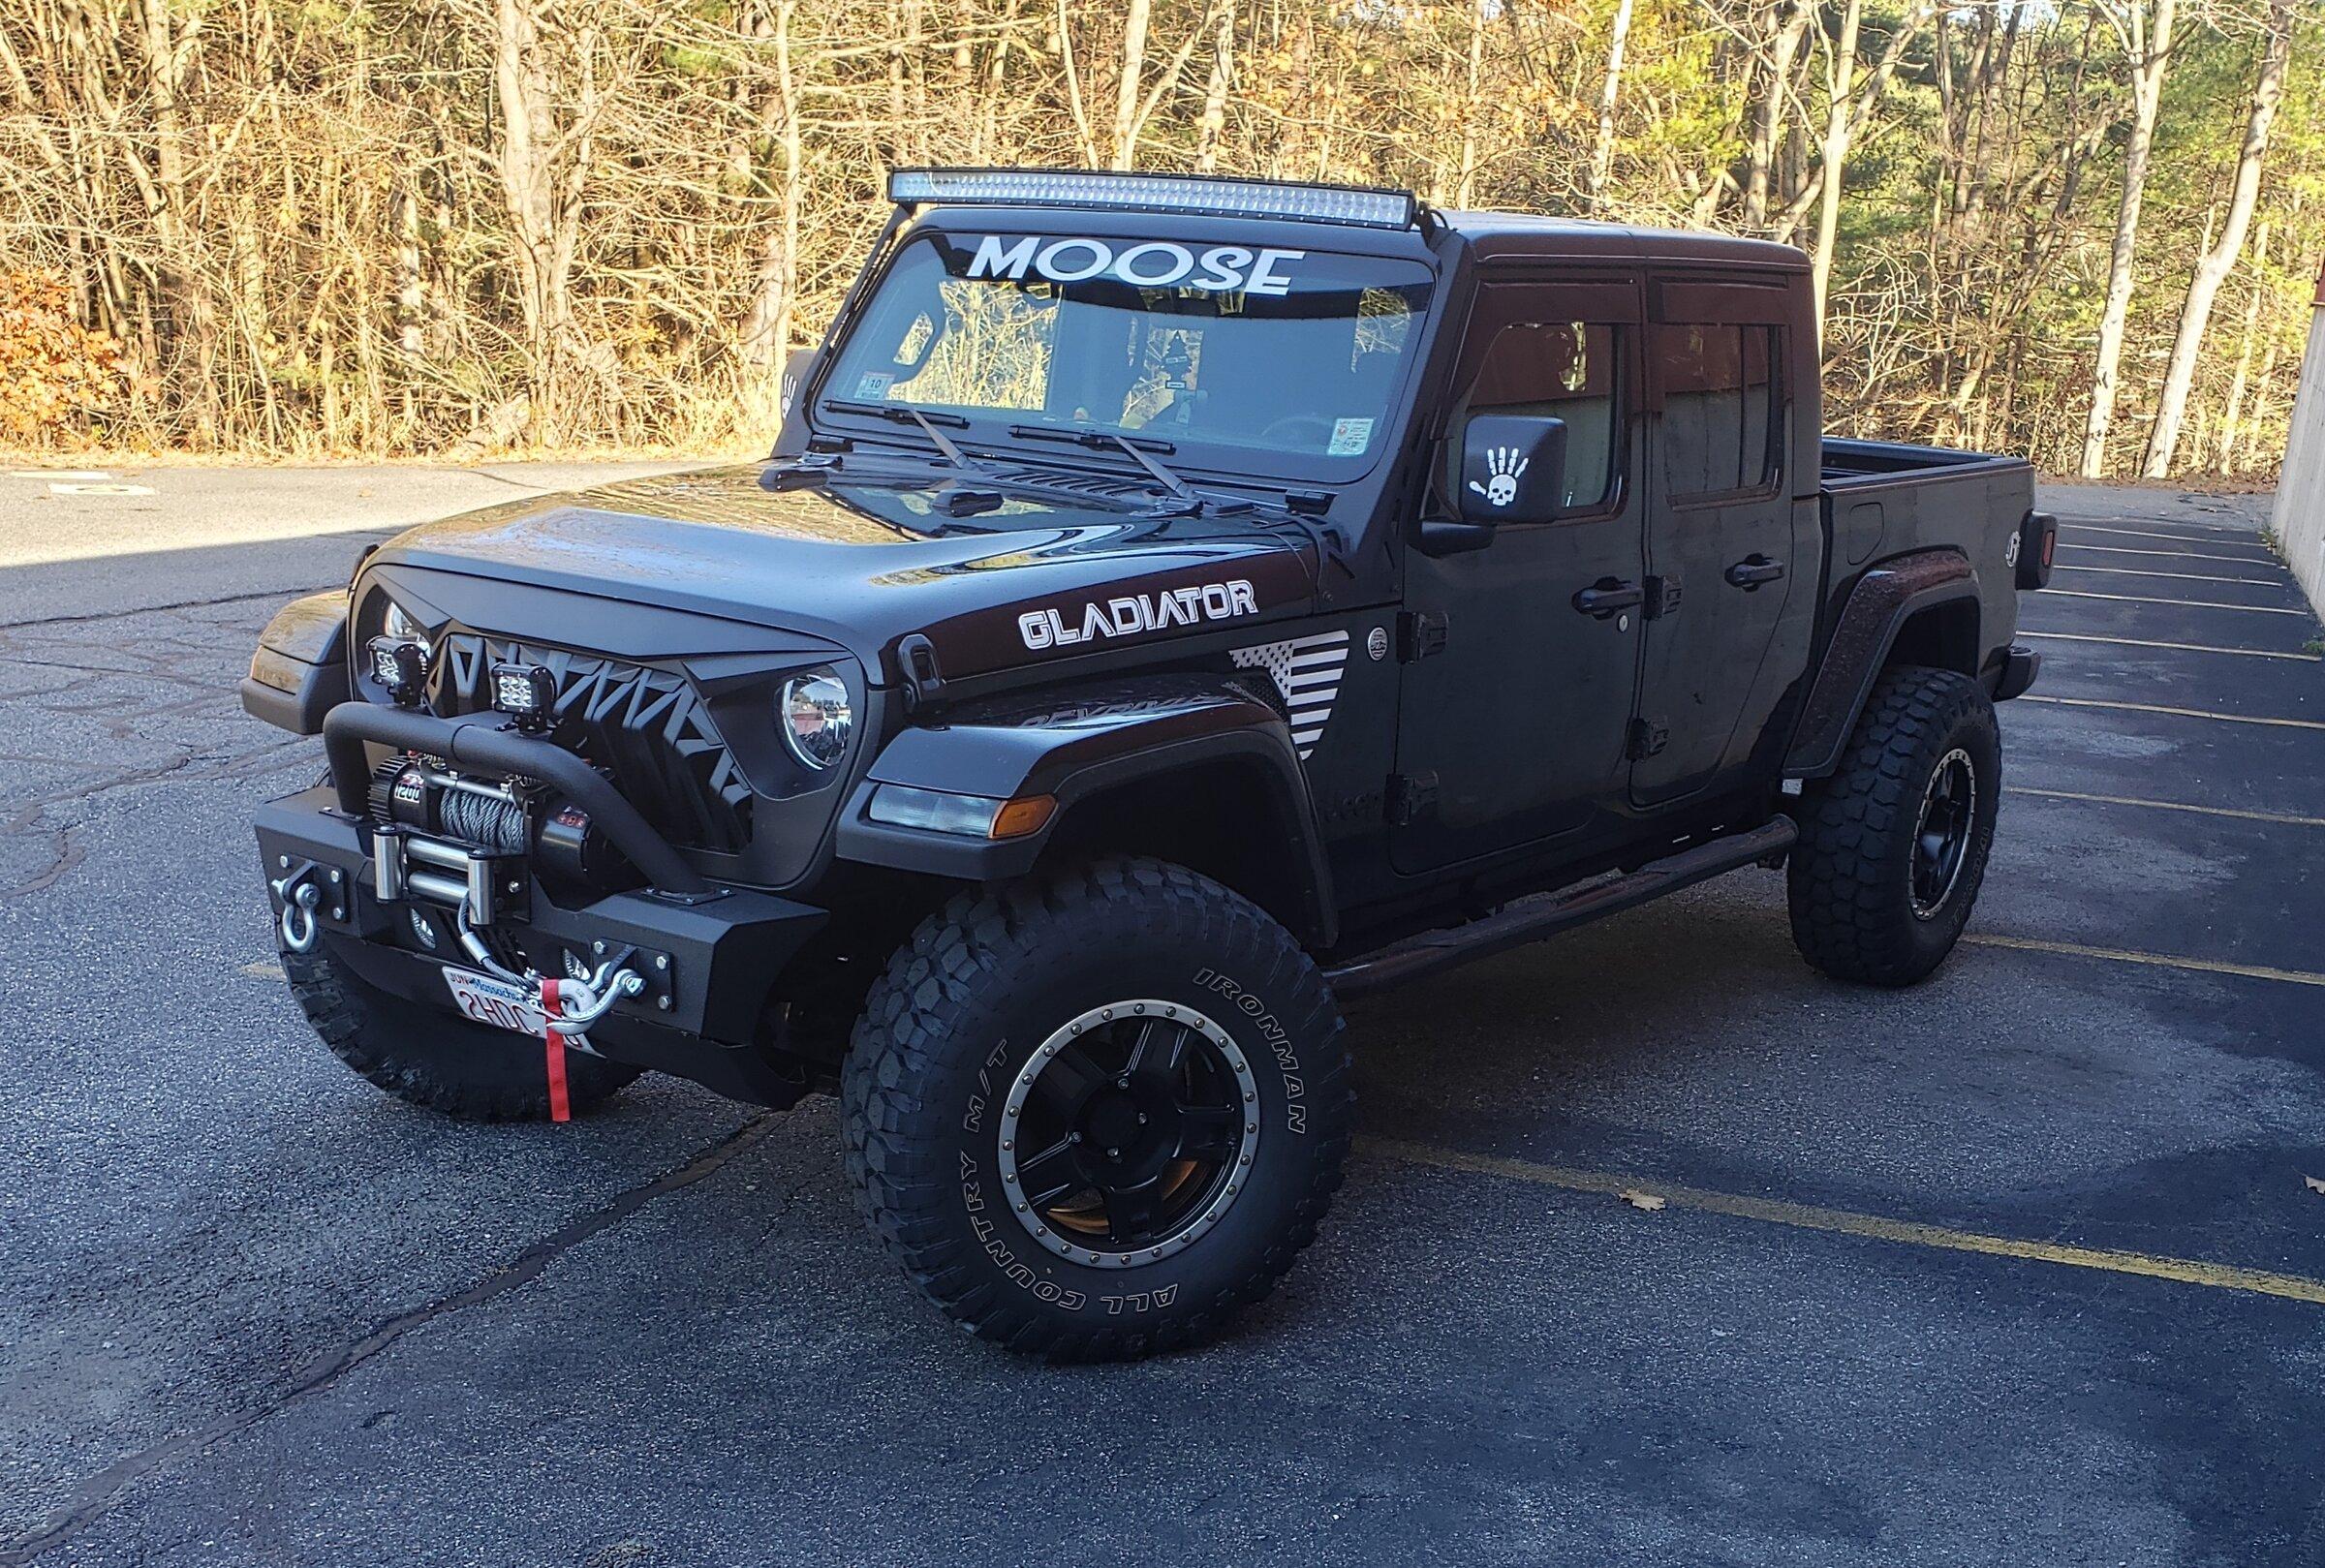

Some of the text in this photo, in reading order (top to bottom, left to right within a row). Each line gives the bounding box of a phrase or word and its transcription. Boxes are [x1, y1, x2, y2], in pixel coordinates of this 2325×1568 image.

[967, 235, 1305, 295] MOOSE
[870, 379, 882, 388] 10
[1018, 579, 1258, 650] GLADIATOR
[450, 973, 523, 1001] JUN Massachu
[1193, 968, 1306, 1134] IRONMAN
[960, 1038, 1179, 1314] ALL COUNTRY M/T
